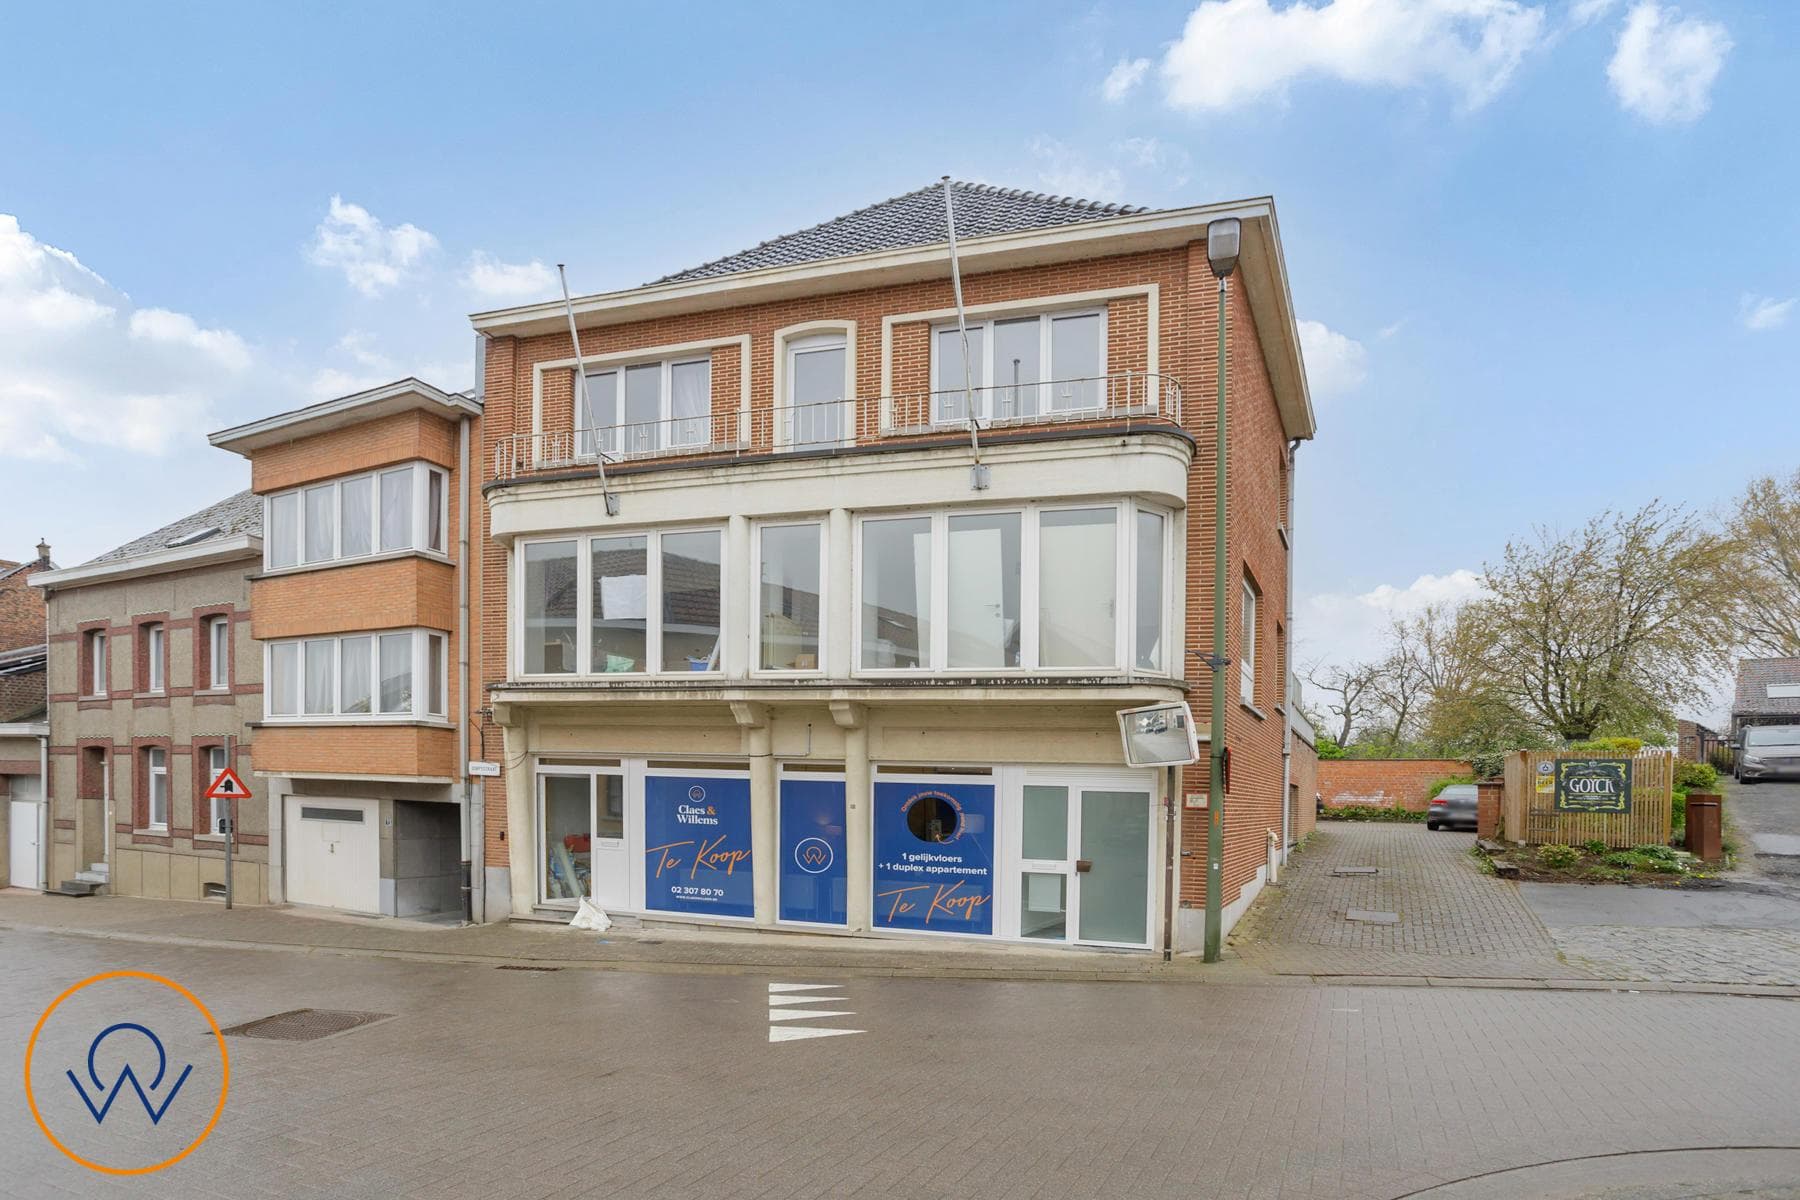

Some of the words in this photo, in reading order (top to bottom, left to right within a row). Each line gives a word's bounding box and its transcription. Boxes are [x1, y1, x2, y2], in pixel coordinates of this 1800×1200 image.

[1569, 778, 1615, 793] GOYCK
[678, 804, 705, 815] Claes
[706, 805, 716, 815] &
[676, 814, 719, 825] Willems
[645, 841, 695, 879] Te
[690, 834, 752, 880] Koop
[908, 853, 963, 863] gelijkvloers
[892, 863, 924, 873] duplex
[926, 865, 988, 875] appartement
[671, 886, 682, 894] 02
[683, 887, 699, 895] 307
[700, 888, 712, 896] 80
[877, 885, 930, 923] Te
[925, 880, 991, 924] Koop
